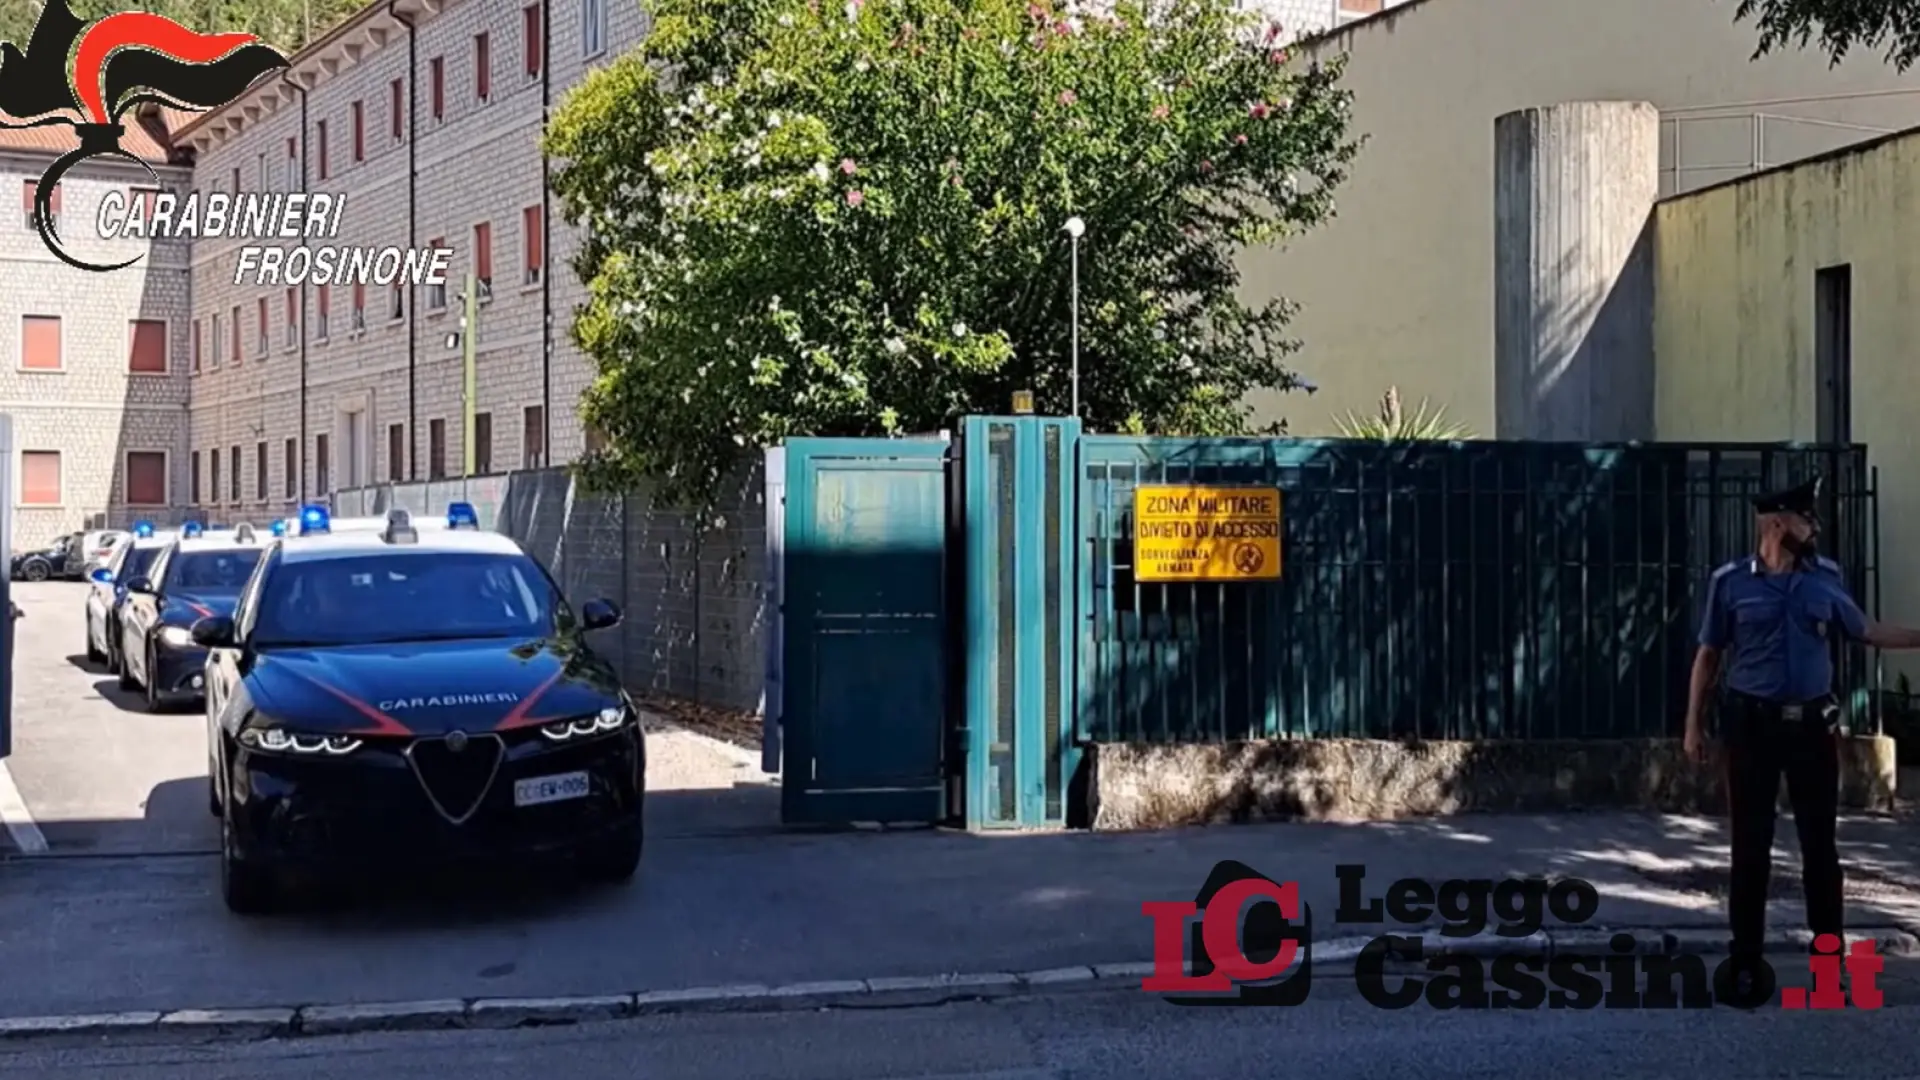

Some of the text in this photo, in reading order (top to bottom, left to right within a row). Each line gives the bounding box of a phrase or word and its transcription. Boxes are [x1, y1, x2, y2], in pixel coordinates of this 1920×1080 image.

[1146, 497, 1272, 514] ZONA MILITARE
[1140, 521, 1279, 539] DIVIETO DI ACCESSO
[379, 692, 519, 711] CARABINIERI
